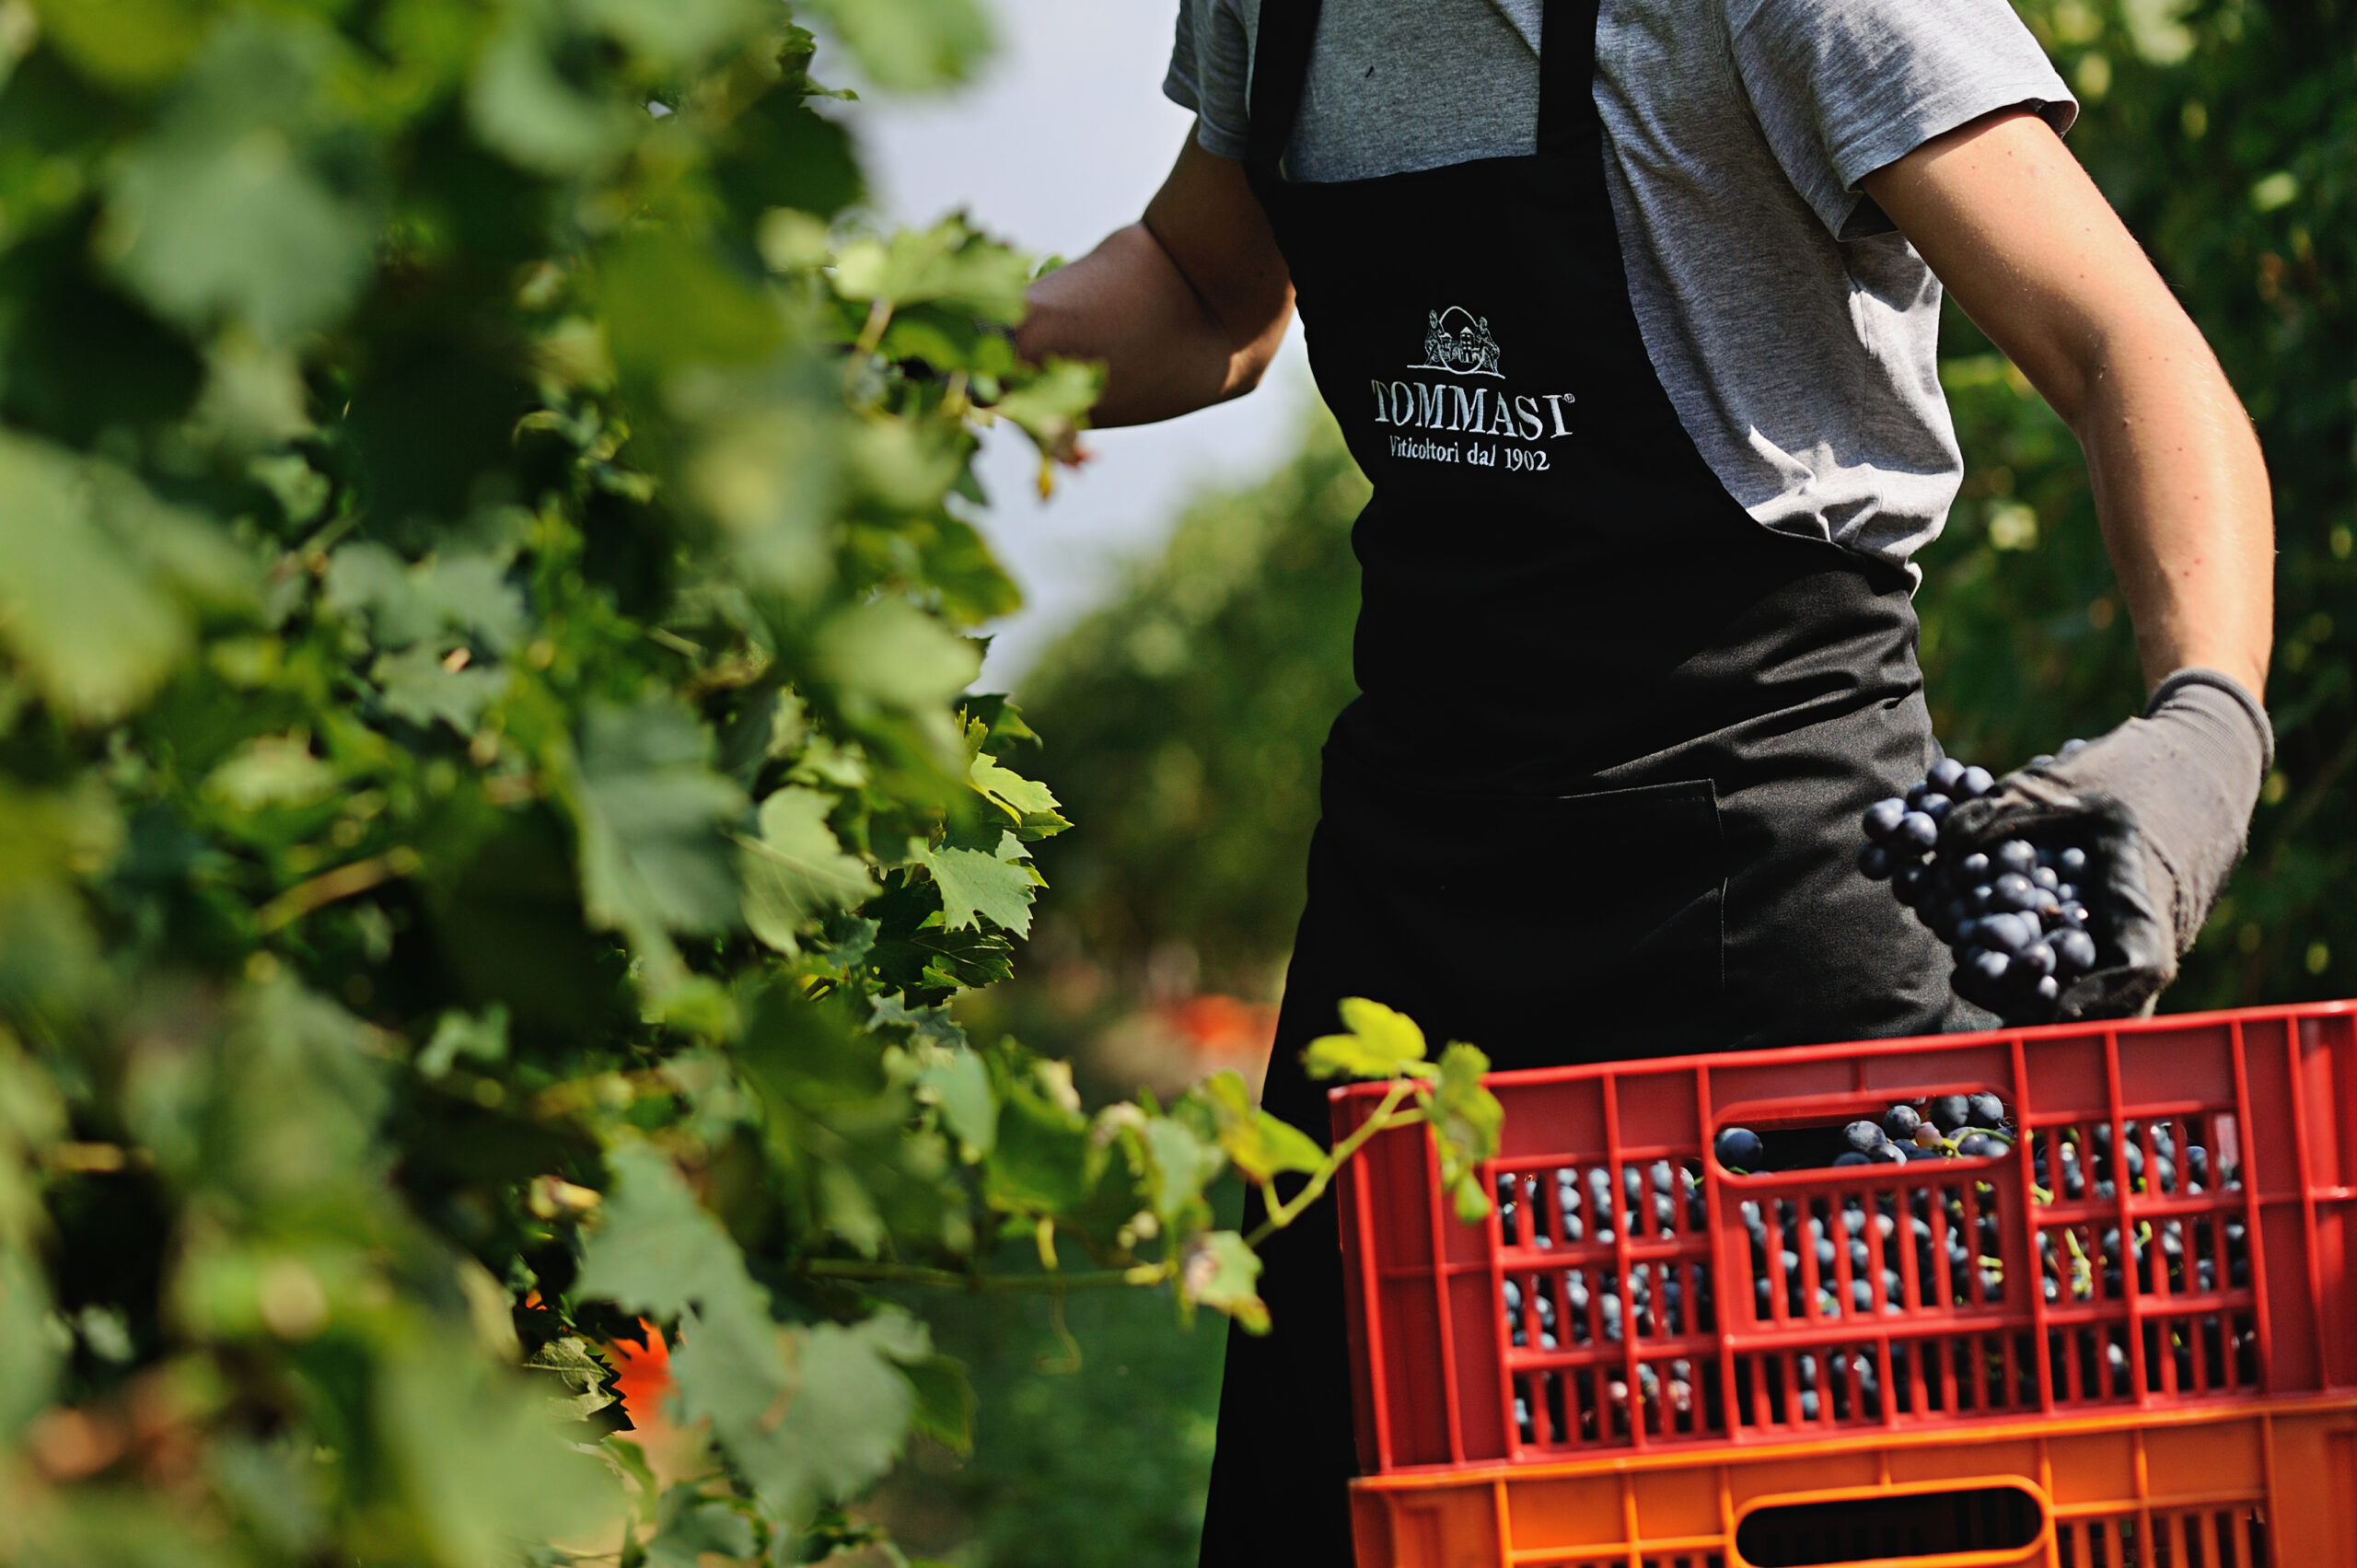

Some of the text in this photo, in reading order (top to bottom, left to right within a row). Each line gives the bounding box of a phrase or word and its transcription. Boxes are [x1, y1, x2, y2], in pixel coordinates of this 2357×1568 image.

[1389, 435, 1550, 471] Viticoltori dal 1902
